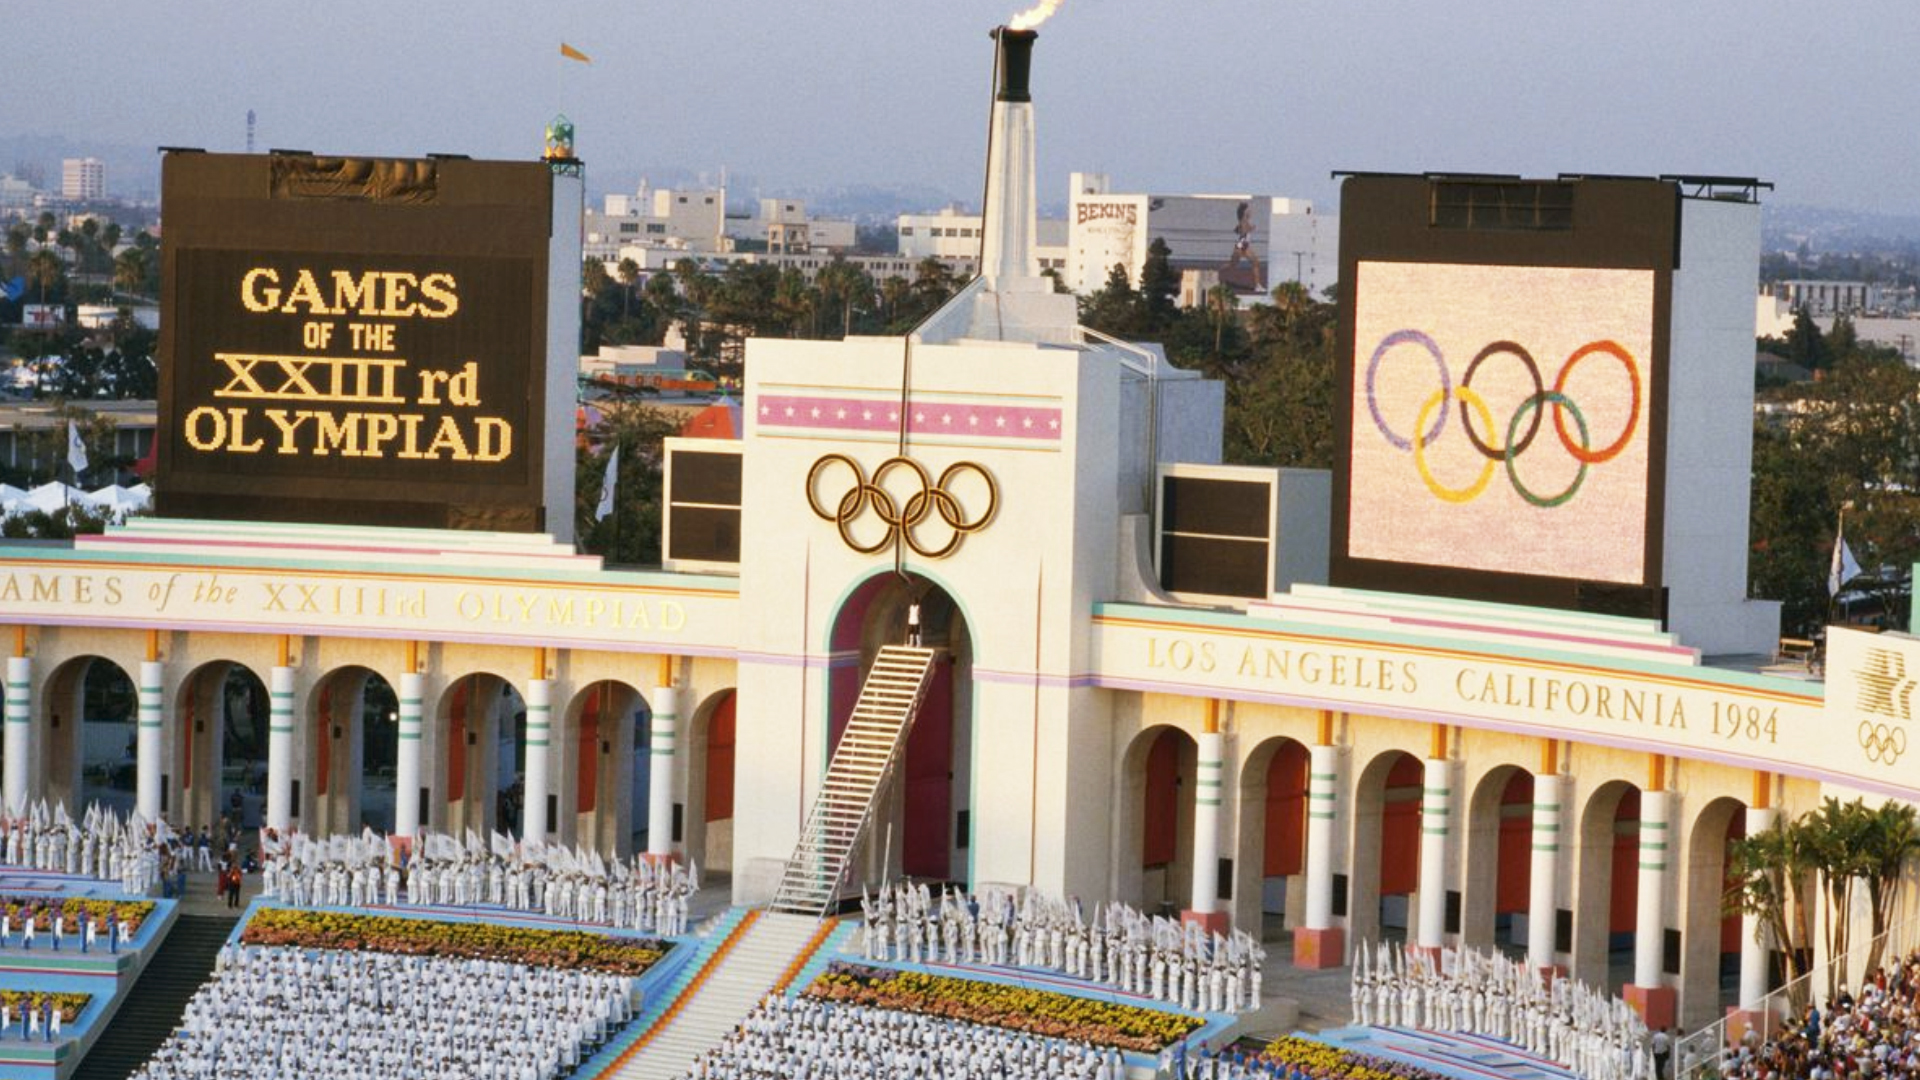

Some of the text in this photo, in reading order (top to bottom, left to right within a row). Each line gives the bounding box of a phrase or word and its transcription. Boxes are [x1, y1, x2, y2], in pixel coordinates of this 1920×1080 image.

[1076, 203, 1137, 225] BEKINS
[242, 268, 459, 318] GAMES
[303, 322, 396, 351] OF THE
[214, 353, 481, 406] XXIII rd
[184, 407, 513, 462] OLYMPIAD
[148, 574, 181, 612] of
[194, 575, 238, 604] the
[455, 590, 687, 632] OLYMPIAD
[1147, 638, 1778, 744] LOS ANGELES CALIFORNIA 1984
